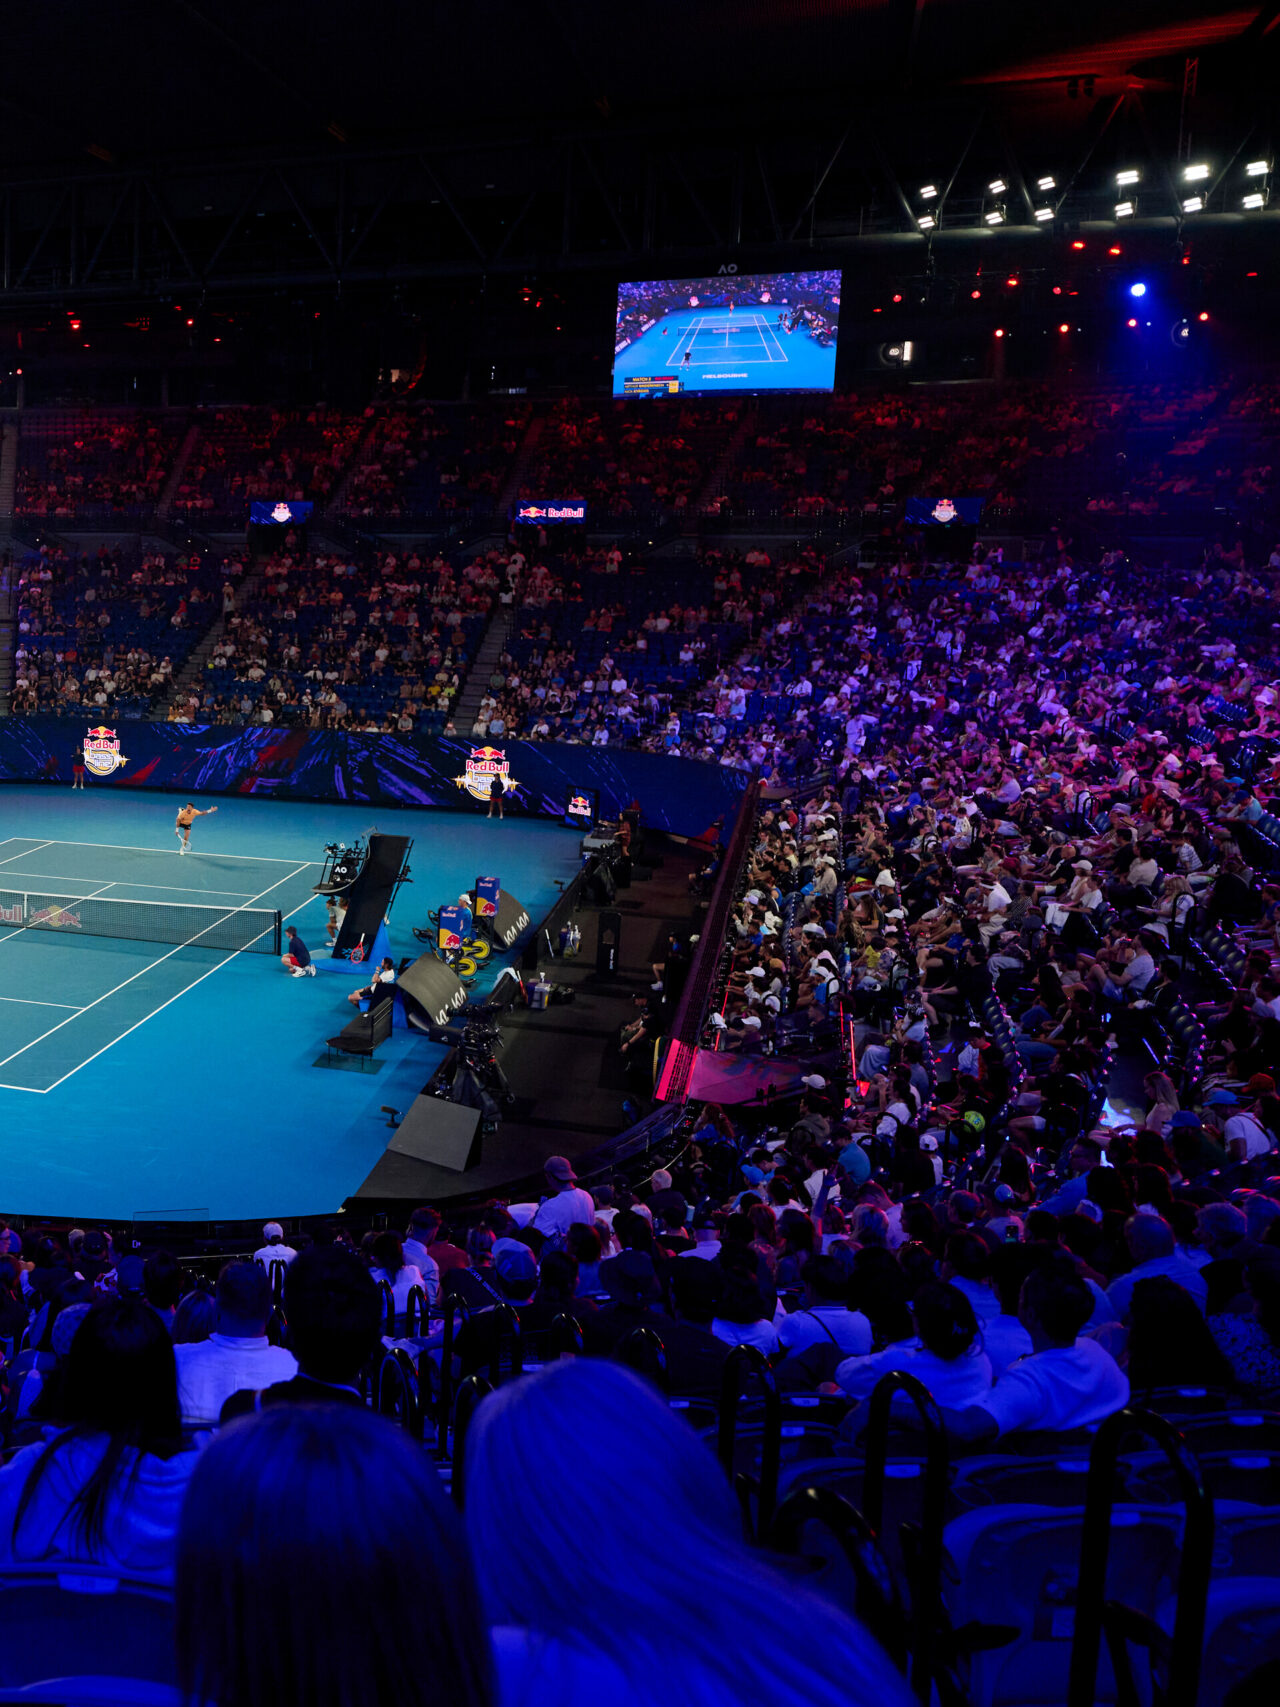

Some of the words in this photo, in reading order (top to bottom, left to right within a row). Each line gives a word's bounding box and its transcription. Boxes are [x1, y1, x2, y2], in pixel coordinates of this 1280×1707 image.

[84, 738, 102, 749] Red
[102, 739, 120, 750] Bull
[466, 760, 487, 771] Red
[488, 761, 509, 773] Bull
[334, 866, 348, 874] AO
